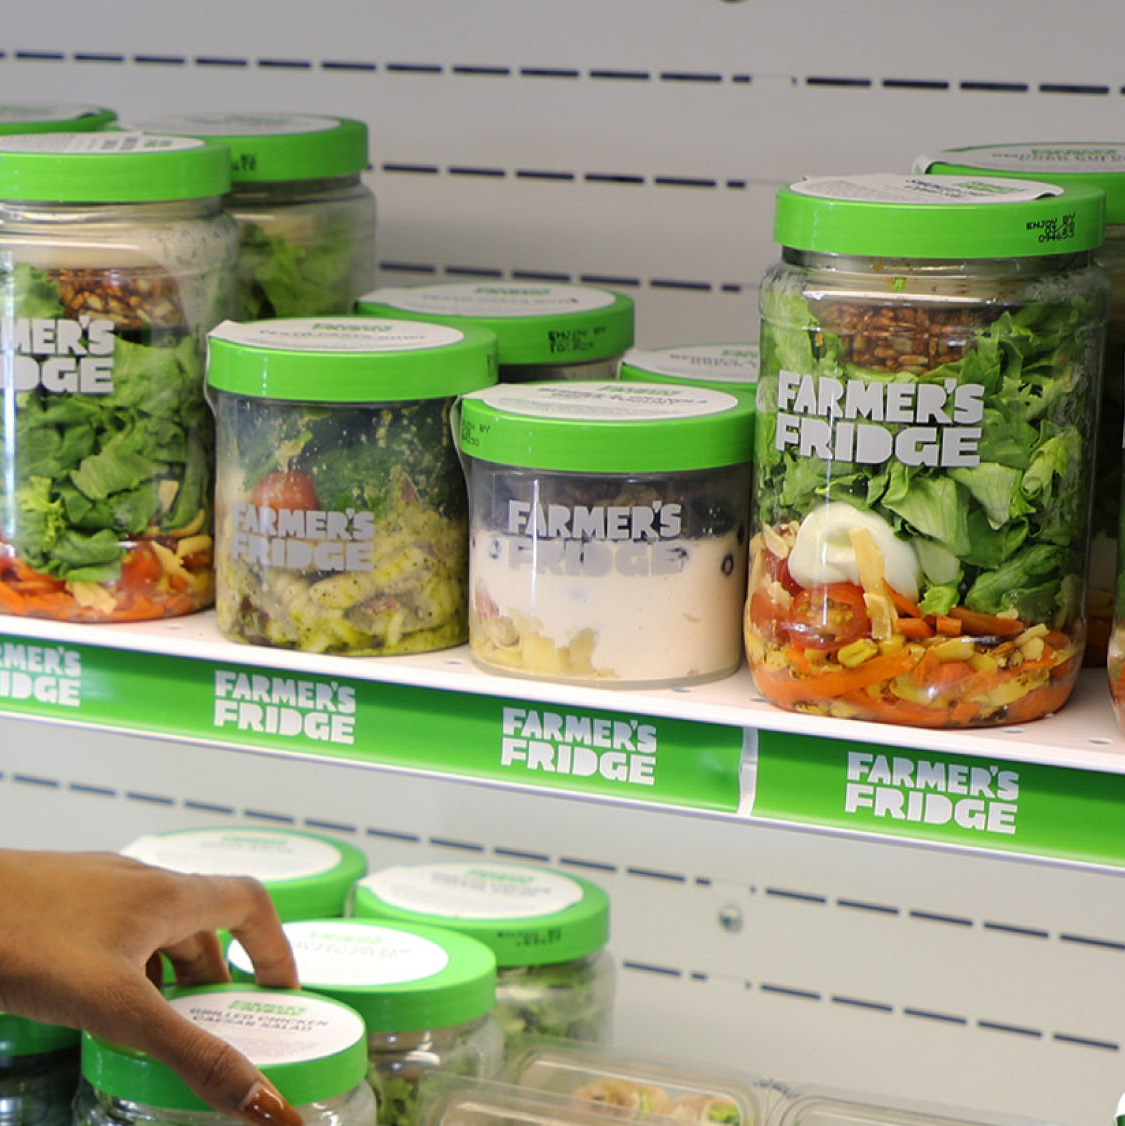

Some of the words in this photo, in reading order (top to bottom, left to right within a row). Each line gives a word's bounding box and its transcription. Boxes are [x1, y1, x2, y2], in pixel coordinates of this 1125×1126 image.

[778, 369, 986, 425] FARMER'S
[774, 412, 983, 468] FRIDGE
[230, 502, 375, 541] FARMER'S
[508, 499, 683, 540] FARMER'S
[230, 531, 375, 573] FRIDGE
[508, 538, 676, 577] FRIDGE
[214, 669, 356, 714] FARMER'S
[214, 699, 355, 746] FRIDGE
[502, 706, 658, 754] FARMER'S
[500, 736, 657, 787] FRIDGE
[846, 749, 1020, 802] FARMER'S
[844, 781, 1019, 835] FRIDGE
